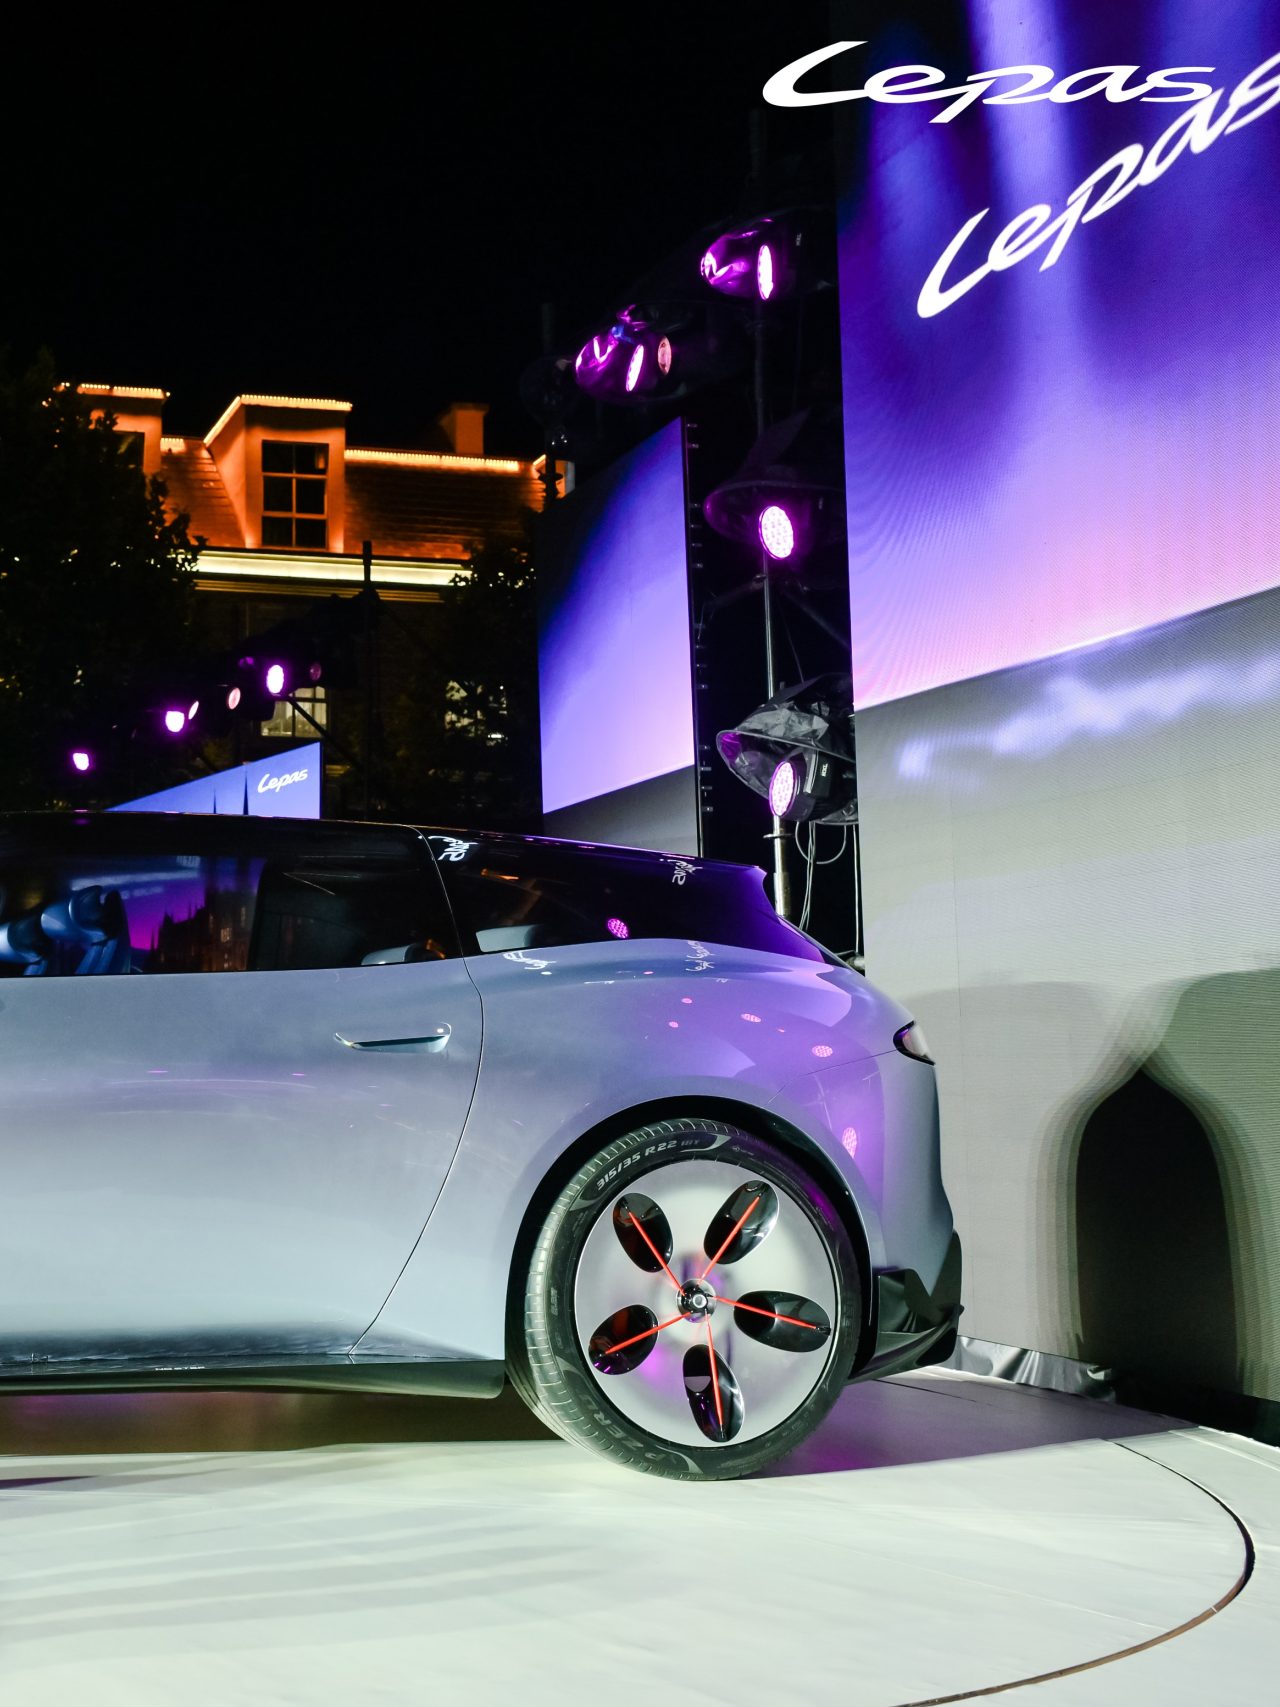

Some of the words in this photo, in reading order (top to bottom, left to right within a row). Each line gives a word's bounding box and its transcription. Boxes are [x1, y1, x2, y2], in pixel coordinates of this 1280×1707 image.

[257, 769, 308, 793] Lepas
[596, 1152, 641, 1191] 315/35
[644, 1140, 678, 1157] R22
